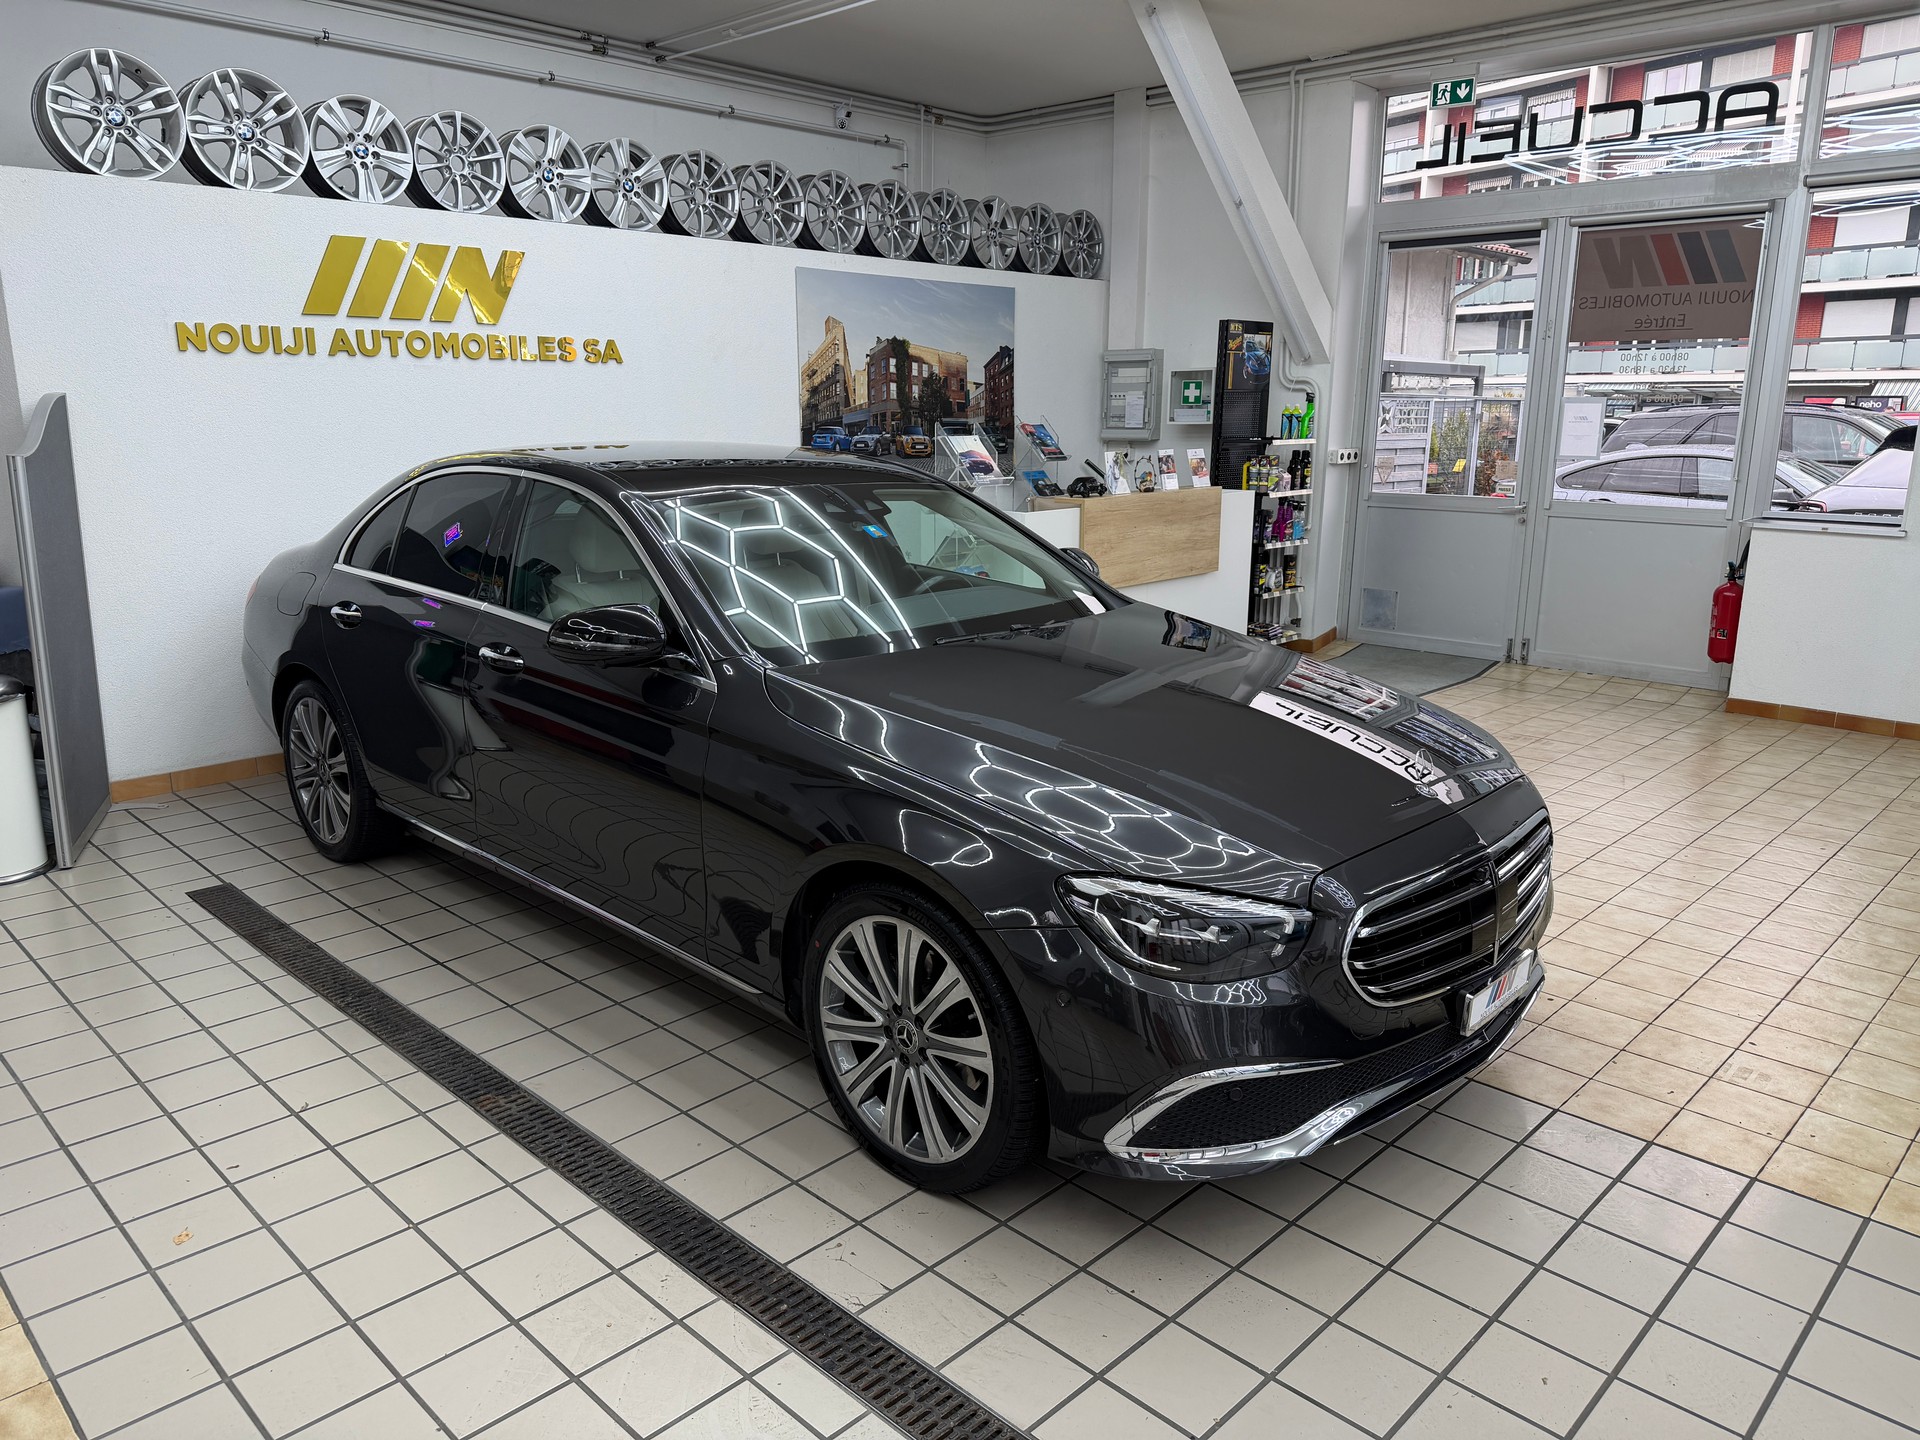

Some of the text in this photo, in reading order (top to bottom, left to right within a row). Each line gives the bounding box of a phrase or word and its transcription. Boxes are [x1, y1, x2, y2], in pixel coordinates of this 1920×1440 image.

[175, 321, 624, 364] NOUIJI AUTOMOBILES SA
[1859, 400, 1882, 408] neho
